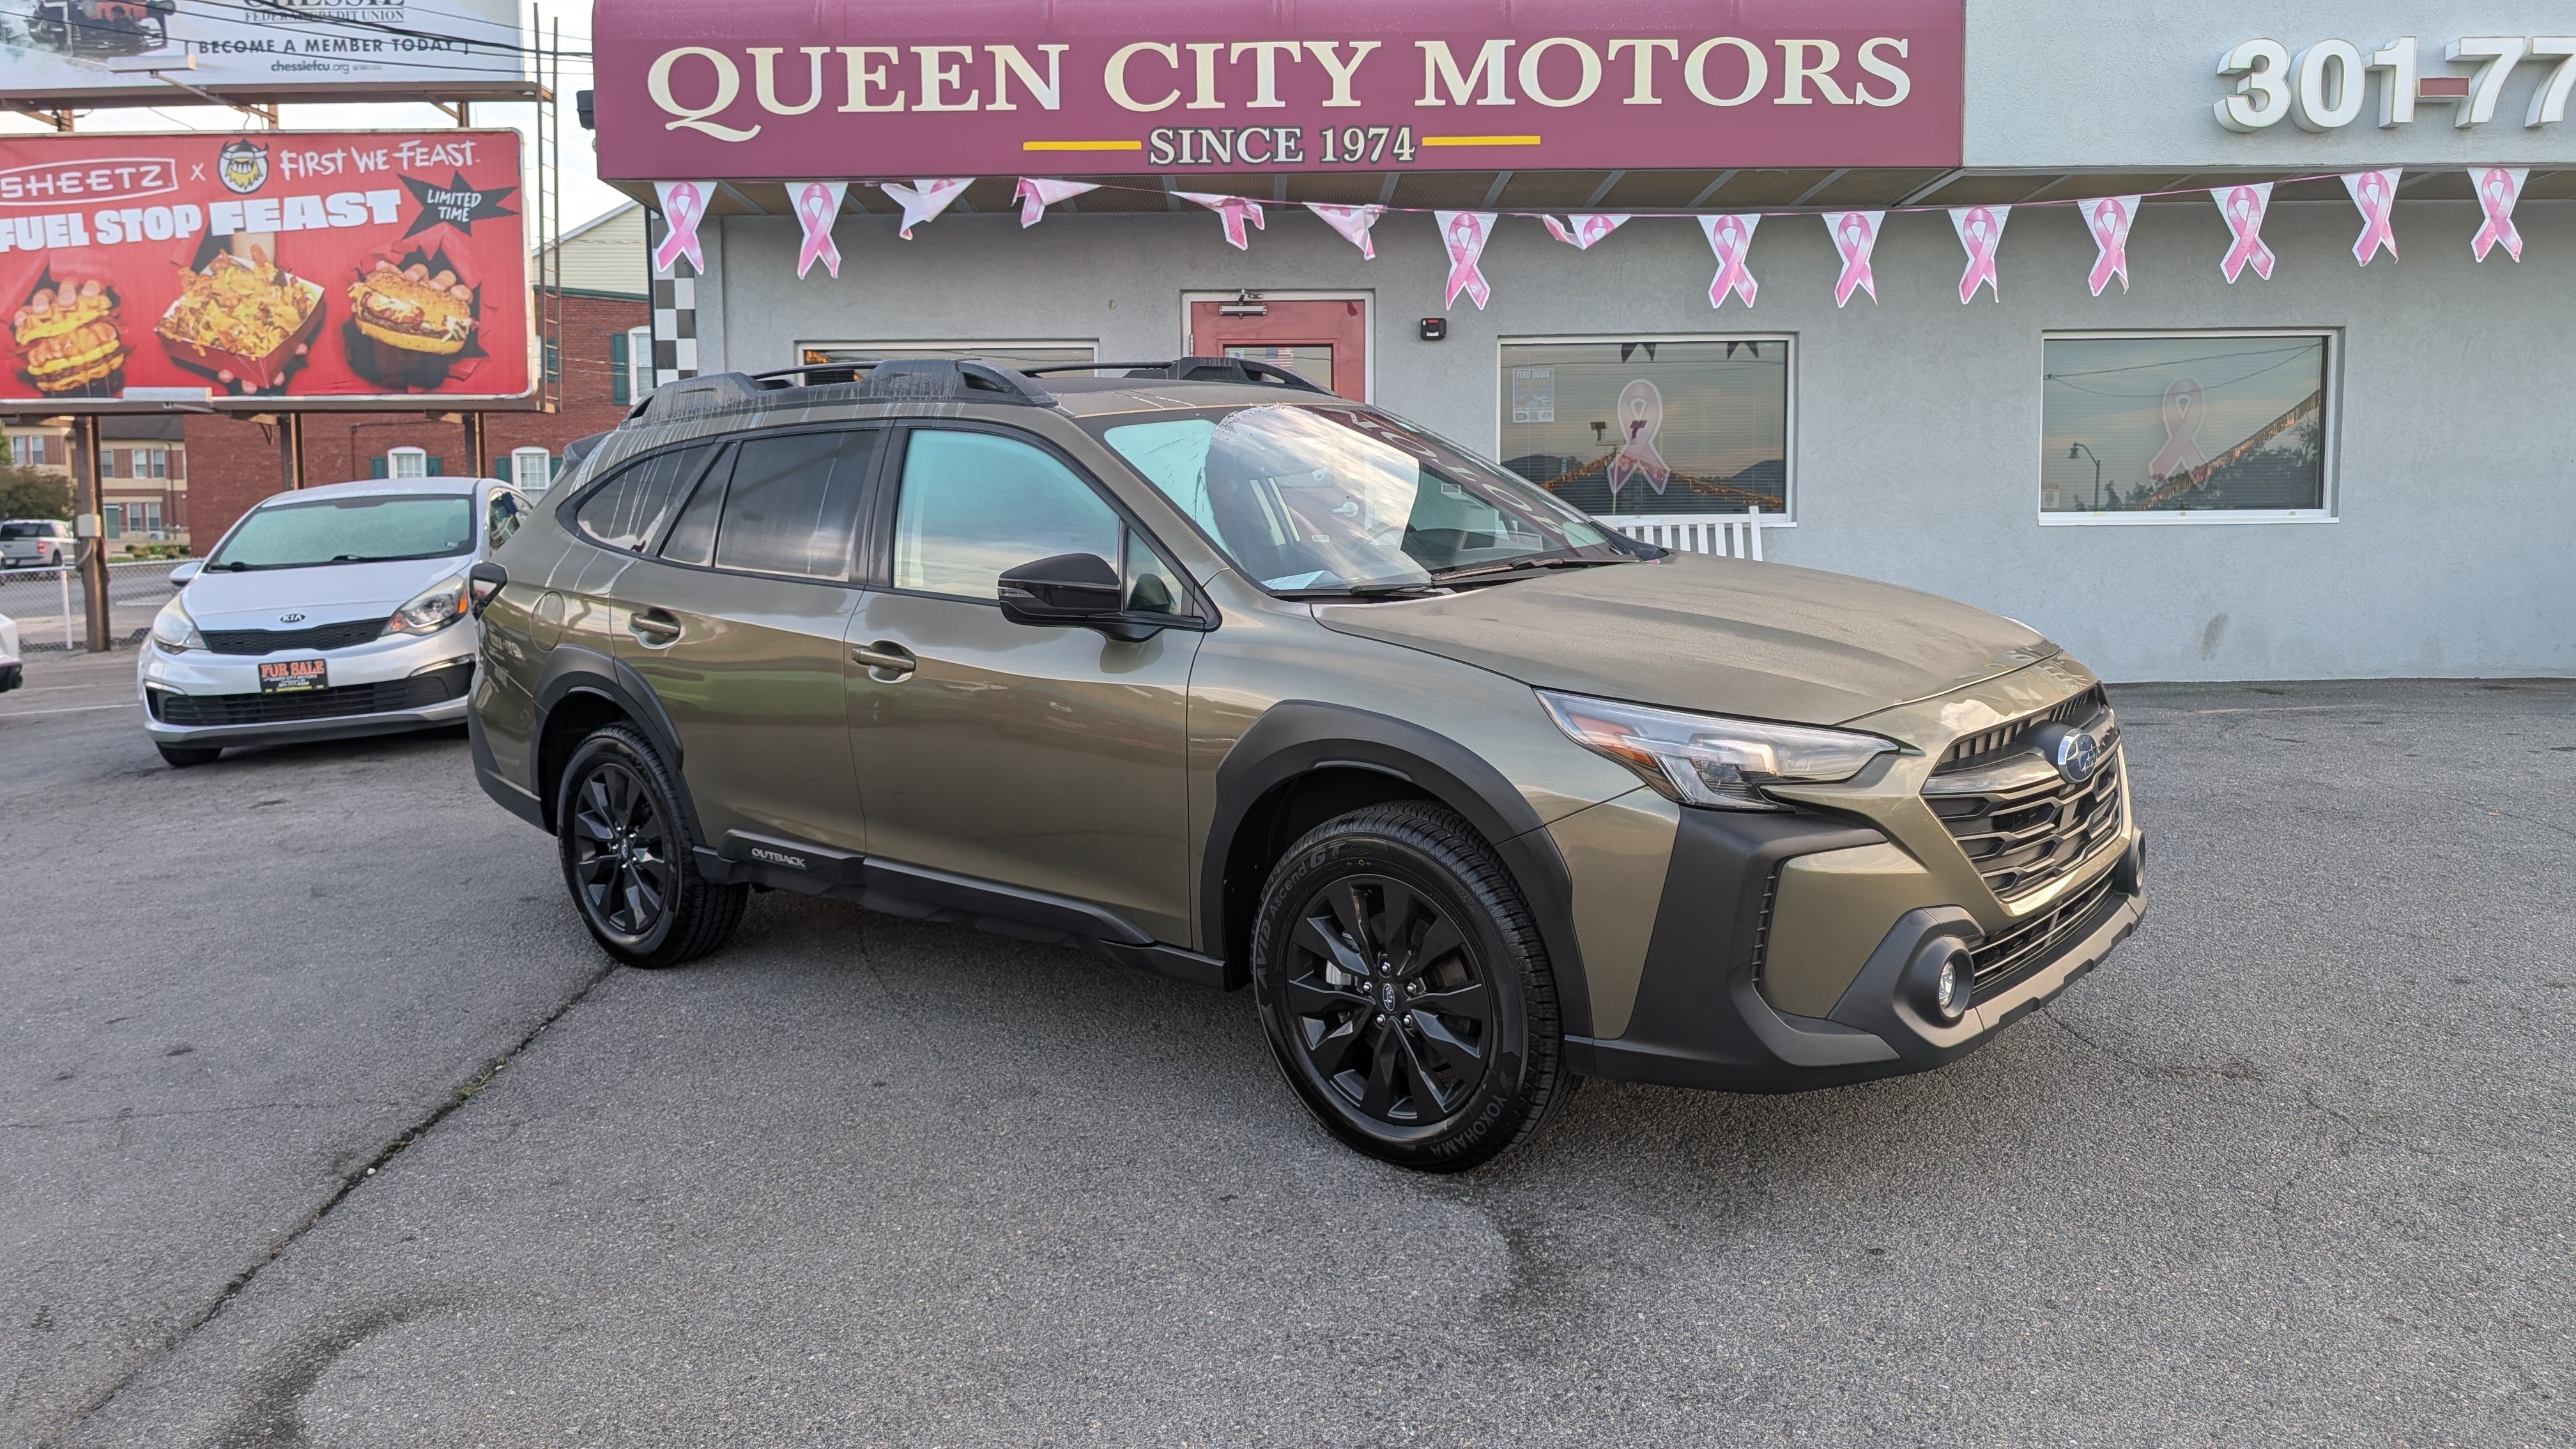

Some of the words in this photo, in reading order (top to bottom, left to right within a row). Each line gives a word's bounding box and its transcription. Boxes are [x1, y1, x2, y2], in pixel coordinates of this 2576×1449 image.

[199, 39, 275, 54] BECOME
[284, 40, 296, 52] A
[305, 38, 383, 52] MEMBER
[391, 38, 454, 52] TODAY
[271, 60, 349, 74] chessiefcu.org
[647, 44, 1070, 142] QUEEN
[1103, 41, 1382, 112] CITY
[1414, 36, 1912, 108] MOTORS
[1149, 126, 1304, 164] SINCE
[1320, 125, 1416, 163] 1974
[279, 148, 347, 181] FIRST
[350, 147, 390, 174] WE
[392, 139, 477, 171] FEAST
[1, 165, 164, 199] SHEETZ
[427, 189, 482, 207] LIMITED
[0, 212, 90, 253] FUEL
[94, 204, 203, 245] STOP
[209, 189, 401, 236] FEAST
[438, 206, 470, 222] TIME
[282, 614, 302, 622] KIA
[290, 660, 325, 675] SALE
[751, 848, 806, 868] OUTBACK
[1256, 919, 1271, 990] AVID
[1269, 861, 1308, 920] Ascend
[1310, 840, 1347, 868] GT
[1430, 1094, 1508, 1157] YOKOHAMA
